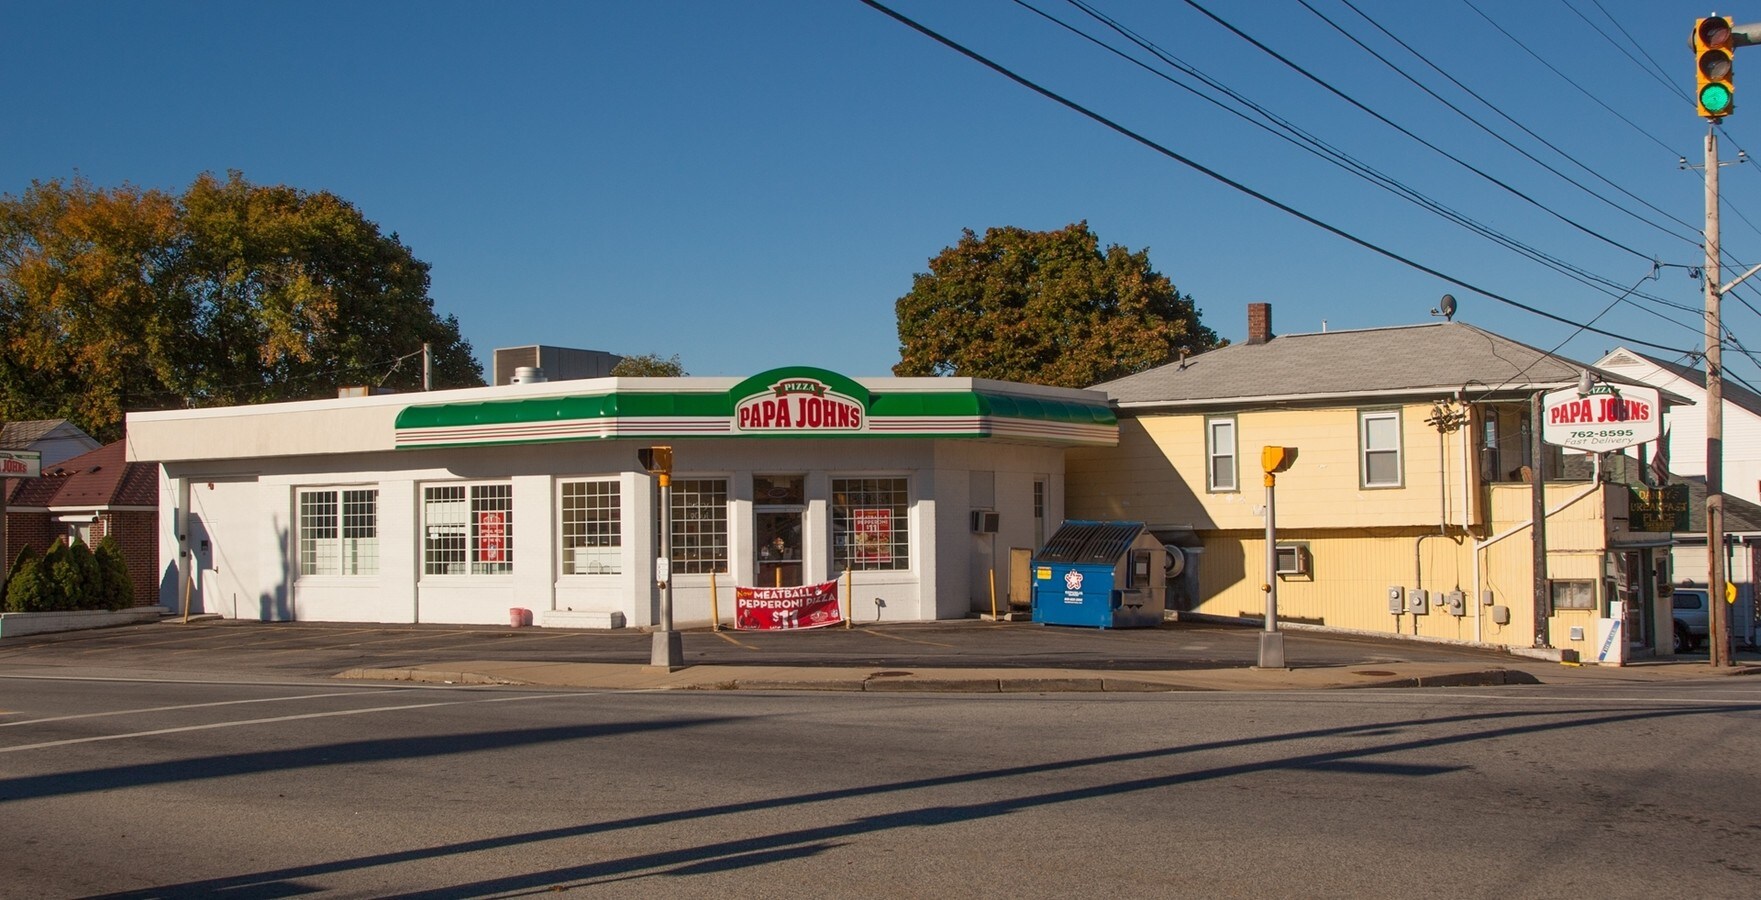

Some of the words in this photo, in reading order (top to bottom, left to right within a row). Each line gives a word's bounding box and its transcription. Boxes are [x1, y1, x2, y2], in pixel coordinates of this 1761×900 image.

[784, 383, 816, 391] PIZZA
[740, 398, 791, 428] PAPA
[796, 397, 859, 428] JOHN'S
[1551, 399, 1593, 424] PAPA
[1597, 398, 1649, 423] JOHN'S
[1570, 430, 1633, 438] 762-8595
[1591, 436, 1634, 445] Delivery
[753, 588, 813, 599] MEATBALL
[739, 598, 802, 609] PEPPERONI
[806, 593, 835, 606] PIZZA
